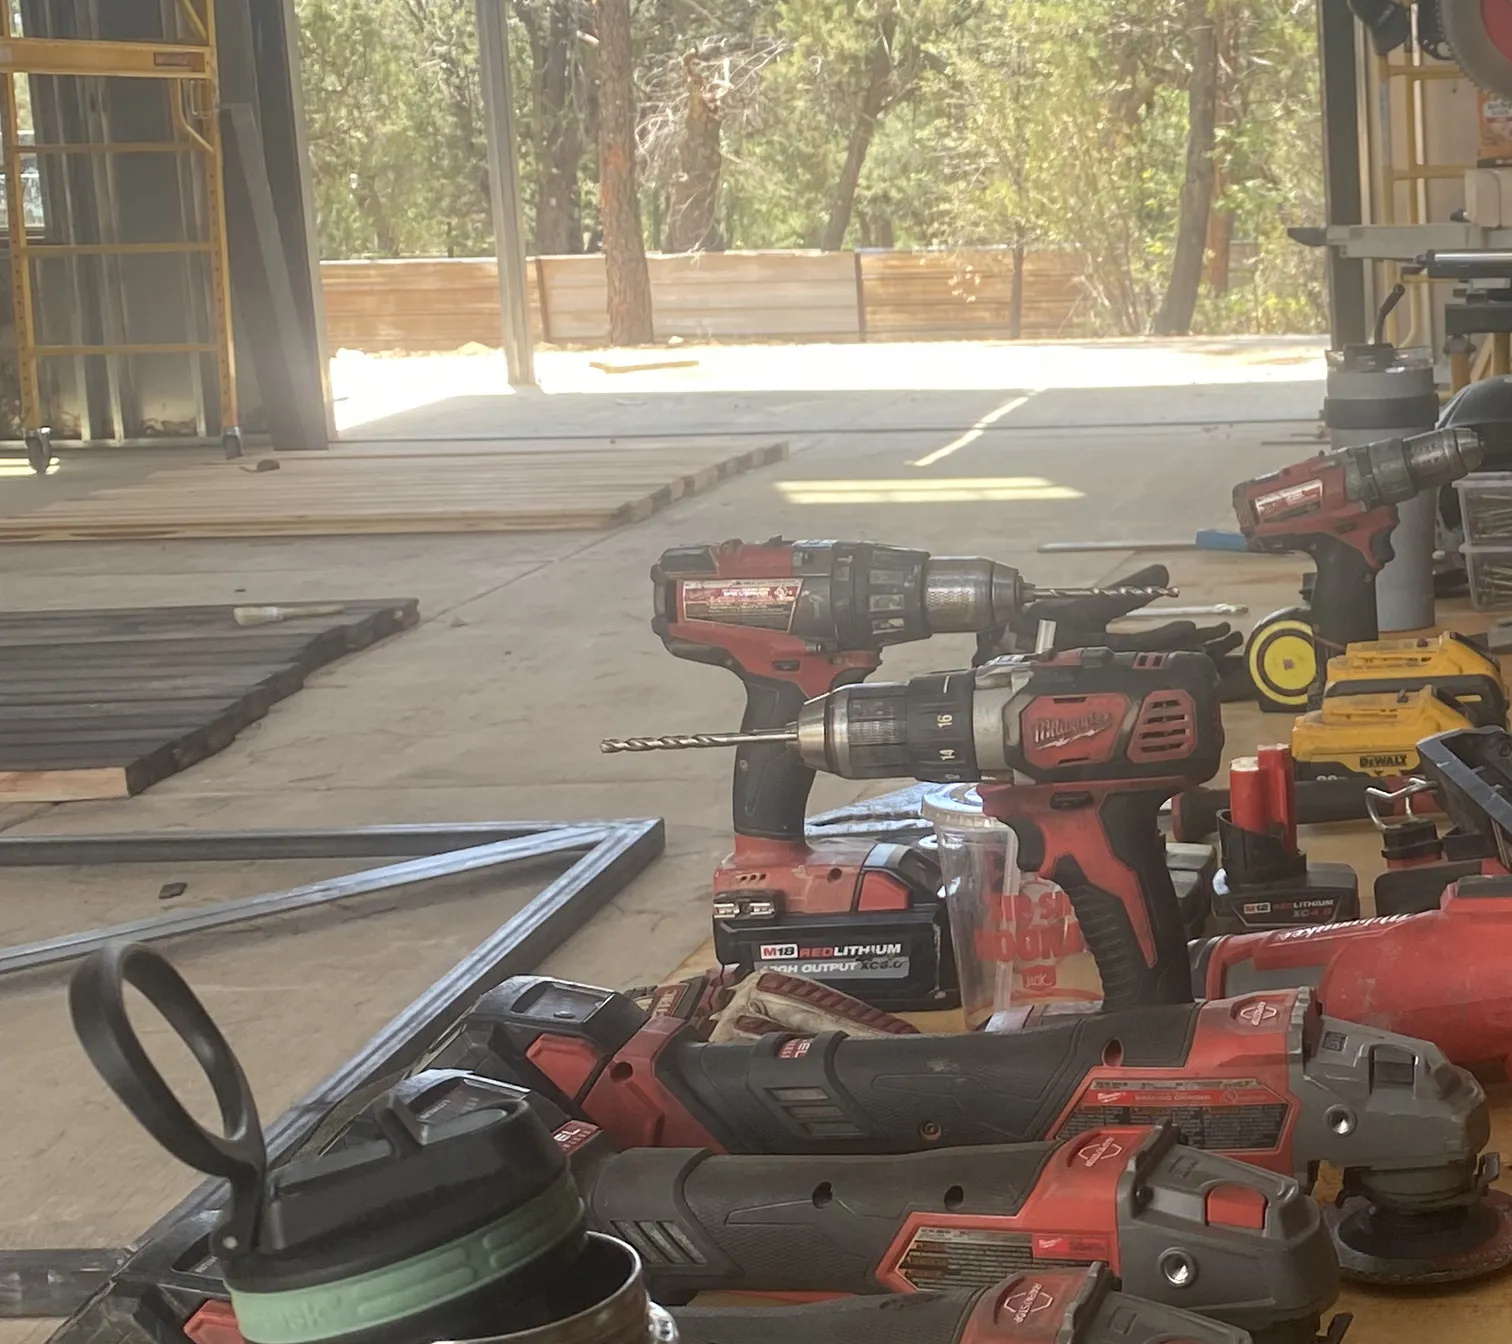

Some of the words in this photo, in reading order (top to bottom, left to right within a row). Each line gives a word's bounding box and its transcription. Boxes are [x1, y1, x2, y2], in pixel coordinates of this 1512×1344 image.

[937, 714, 953, 728] 16
[939, 748, 955, 760] 14
[1360, 755, 1407, 768] DEWALT
[762, 946, 795, 957] M18
[800, 944, 901, 958] REDLITHIUM
[801, 962, 856, 973] OUTPUT
